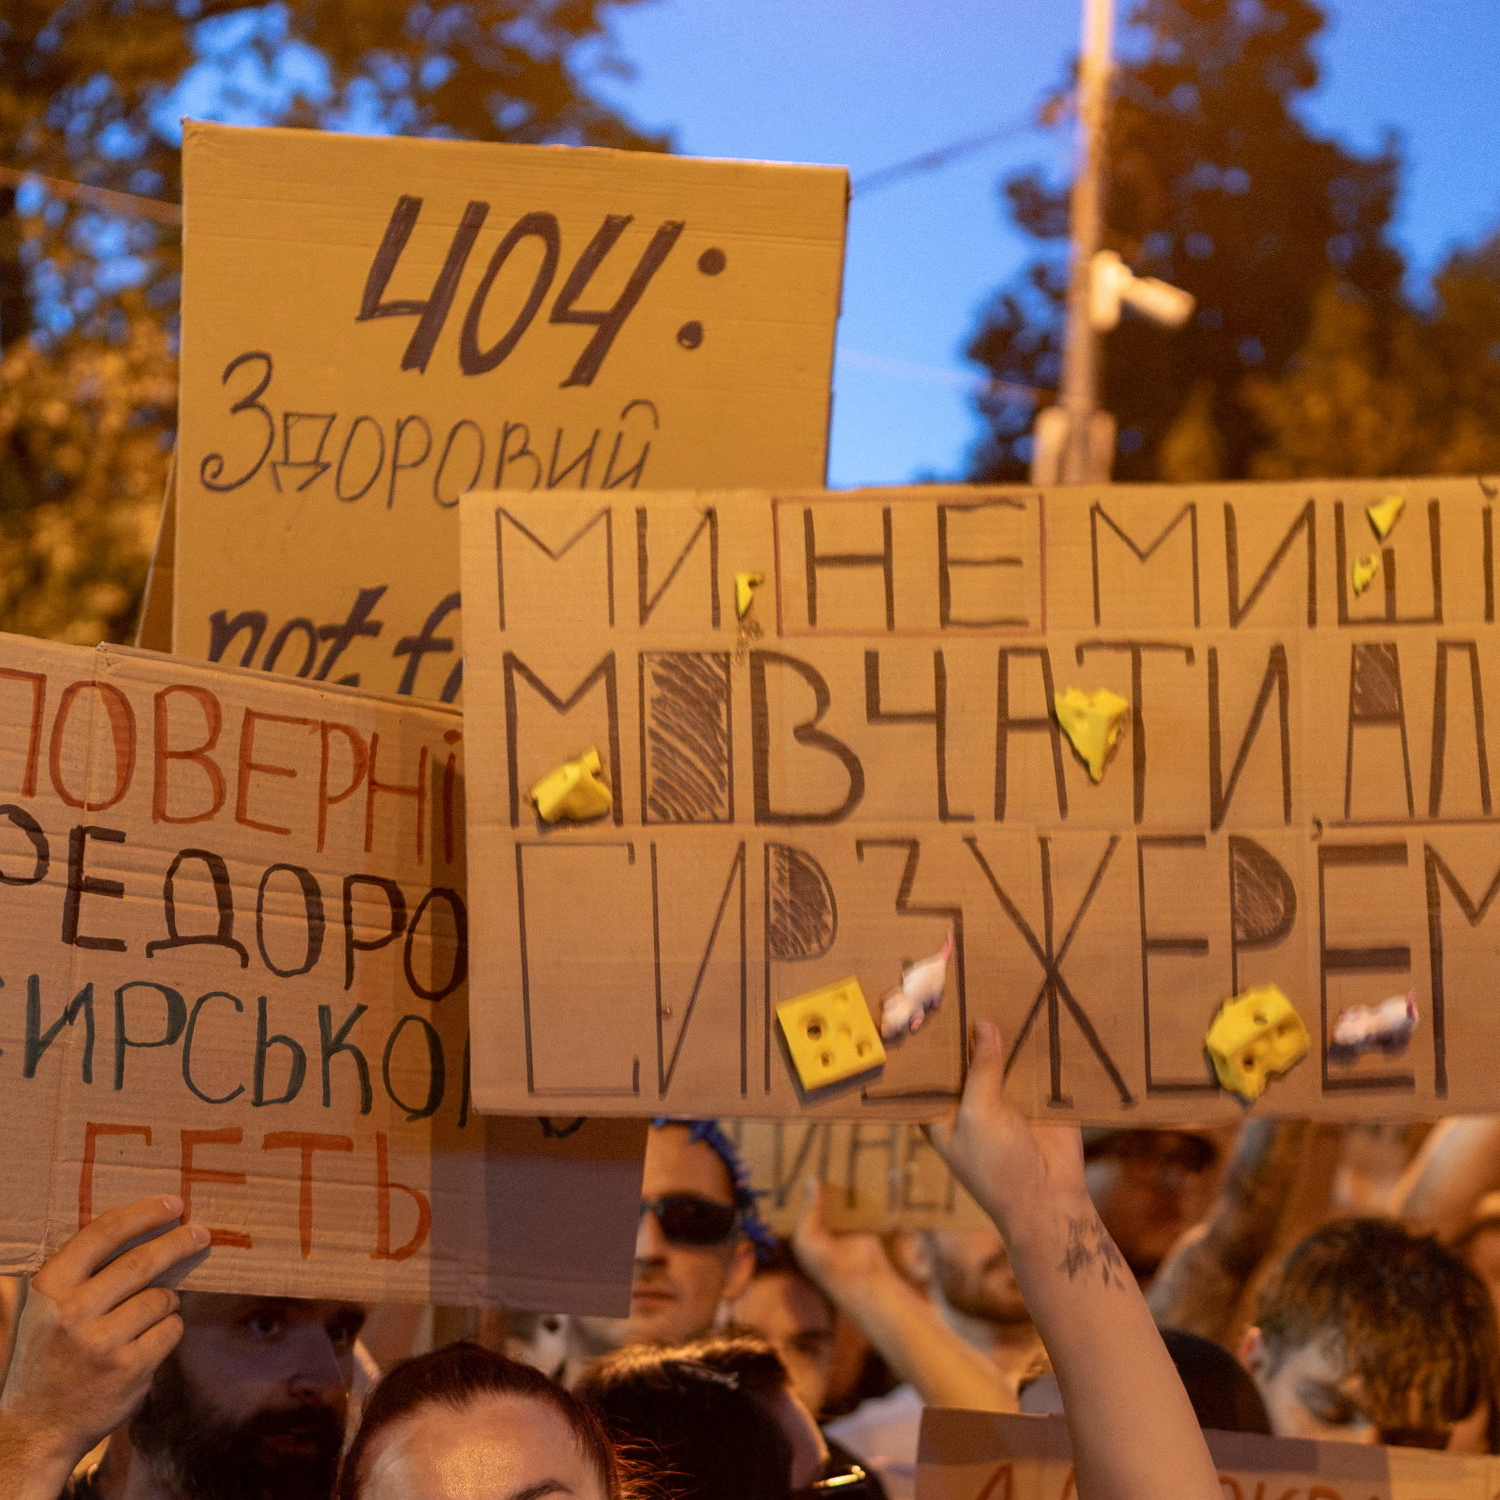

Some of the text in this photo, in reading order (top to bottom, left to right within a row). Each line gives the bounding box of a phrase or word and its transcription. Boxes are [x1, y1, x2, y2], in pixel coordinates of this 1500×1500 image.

[355, 195, 726, 389] 404:
[494, 504, 721, 631] МИ
[805, 500, 1027, 631] НЕ
[78, 1122, 433, 1262] ГЕТЬ
